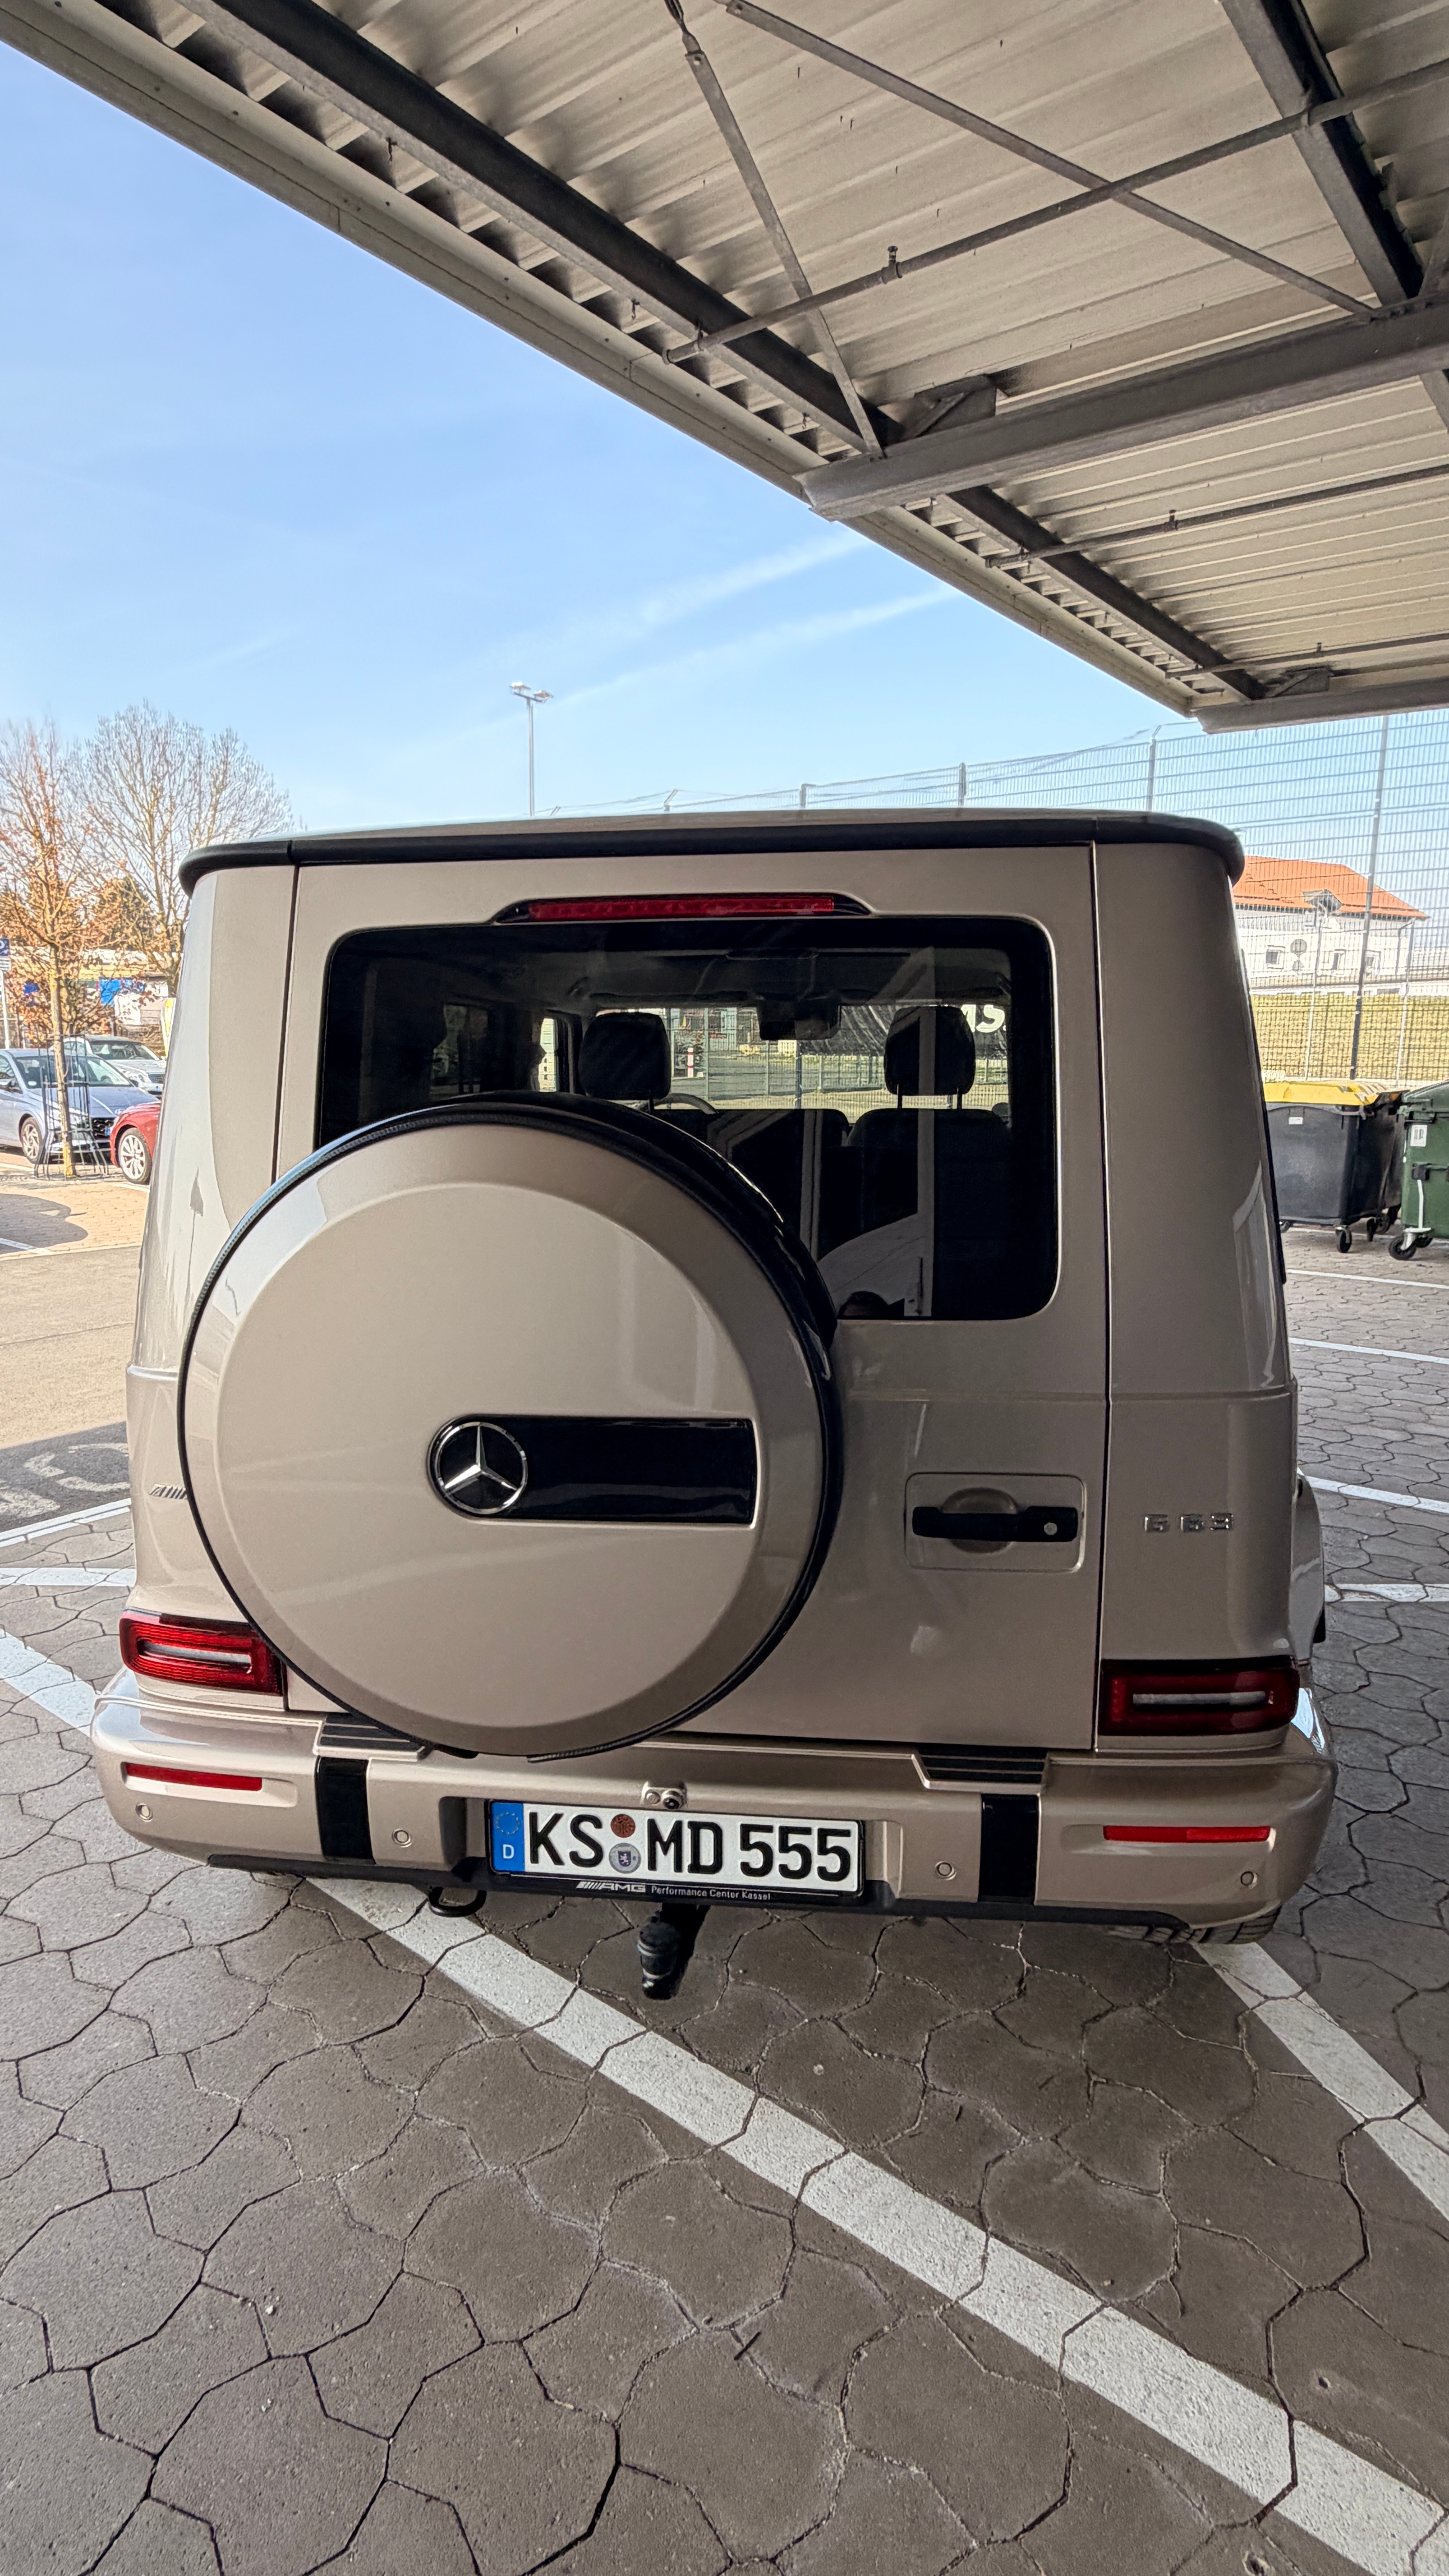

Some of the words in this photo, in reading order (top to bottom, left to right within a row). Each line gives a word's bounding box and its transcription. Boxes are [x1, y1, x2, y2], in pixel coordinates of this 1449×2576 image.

[502, 1844, 514, 1859] D
[529, 1812, 603, 1868] KS
[647, 1818, 723, 1874] MD
[740, 1823, 851, 1881] 555
[597, 1882, 646, 1893] AMG
[651, 1886, 707, 1897] Performance
